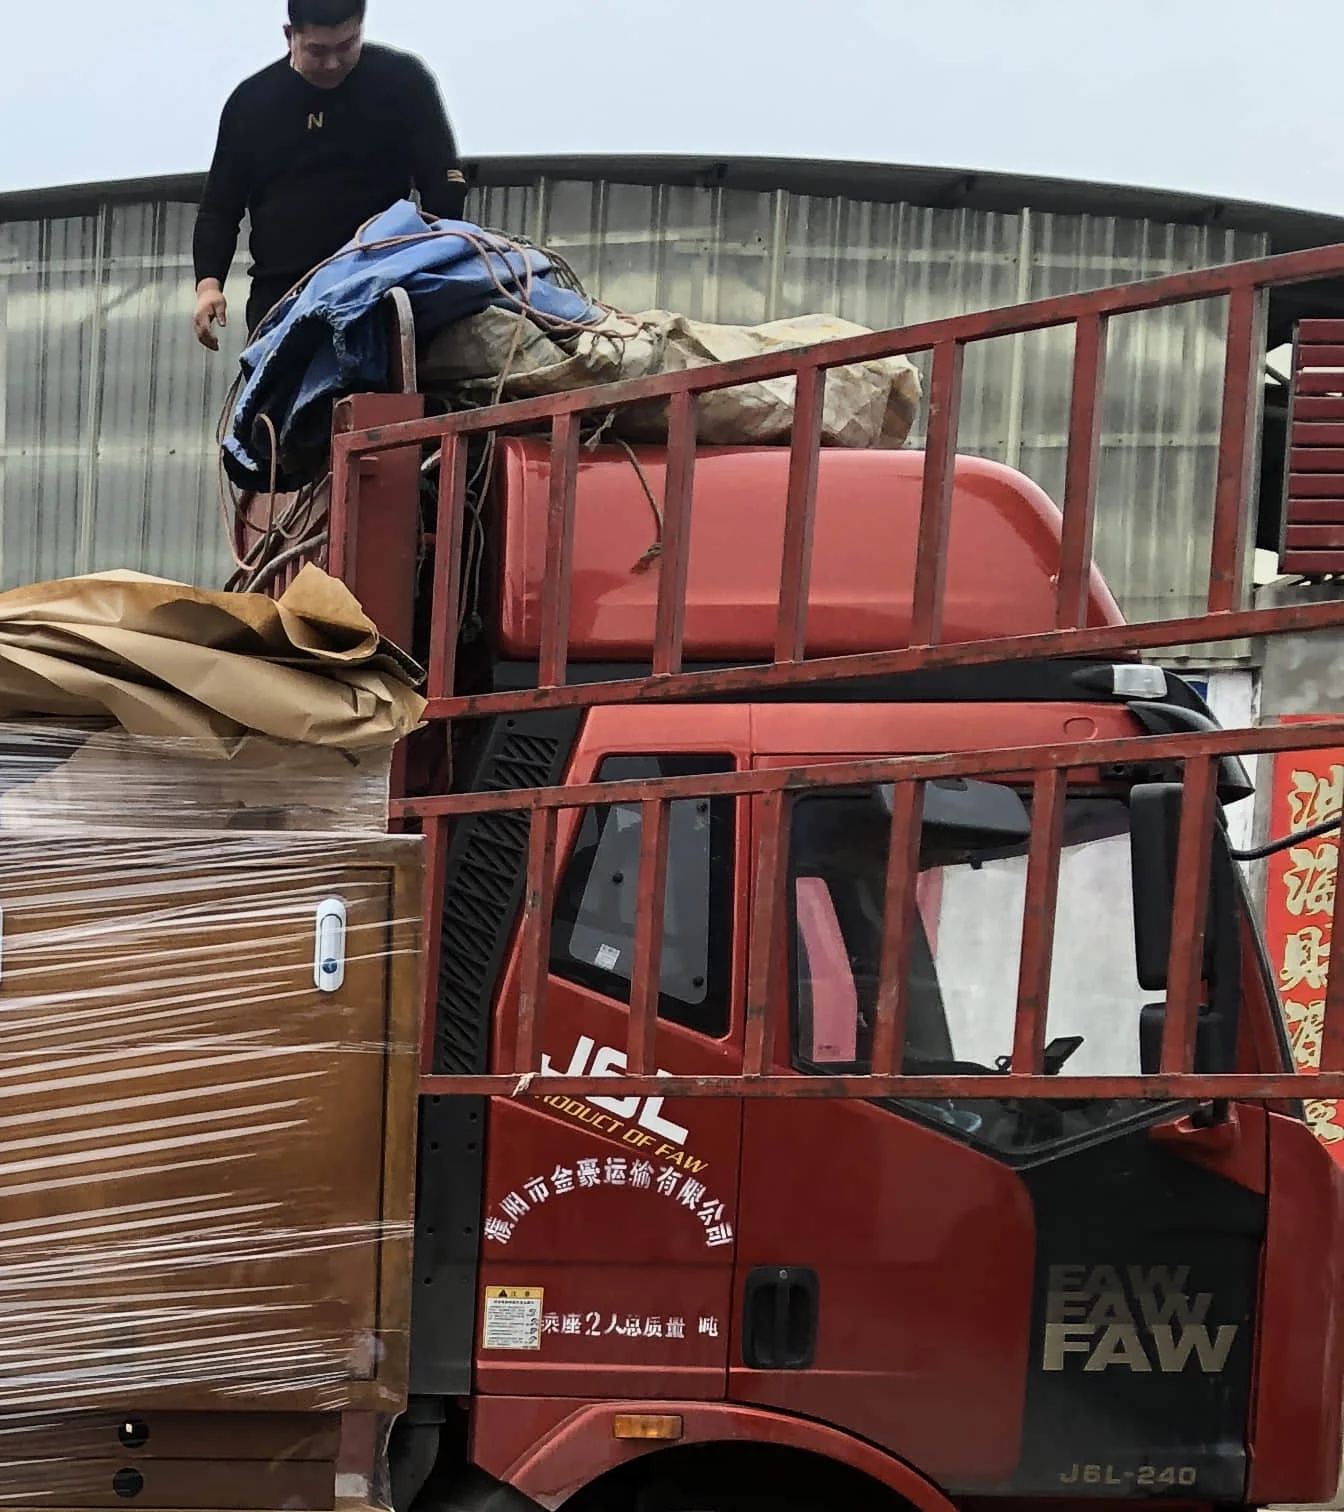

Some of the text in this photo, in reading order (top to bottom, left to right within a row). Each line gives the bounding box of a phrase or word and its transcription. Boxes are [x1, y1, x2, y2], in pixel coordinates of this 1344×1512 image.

[307, 111, 324, 129] N
[622, 1128, 657, 1148] OF
[654, 1143, 709, 1174] FAW
[484, 1157, 734, 1247] 濮阳市金豪运输有限公司
[1042, 1323, 1239, 1372] FAW
